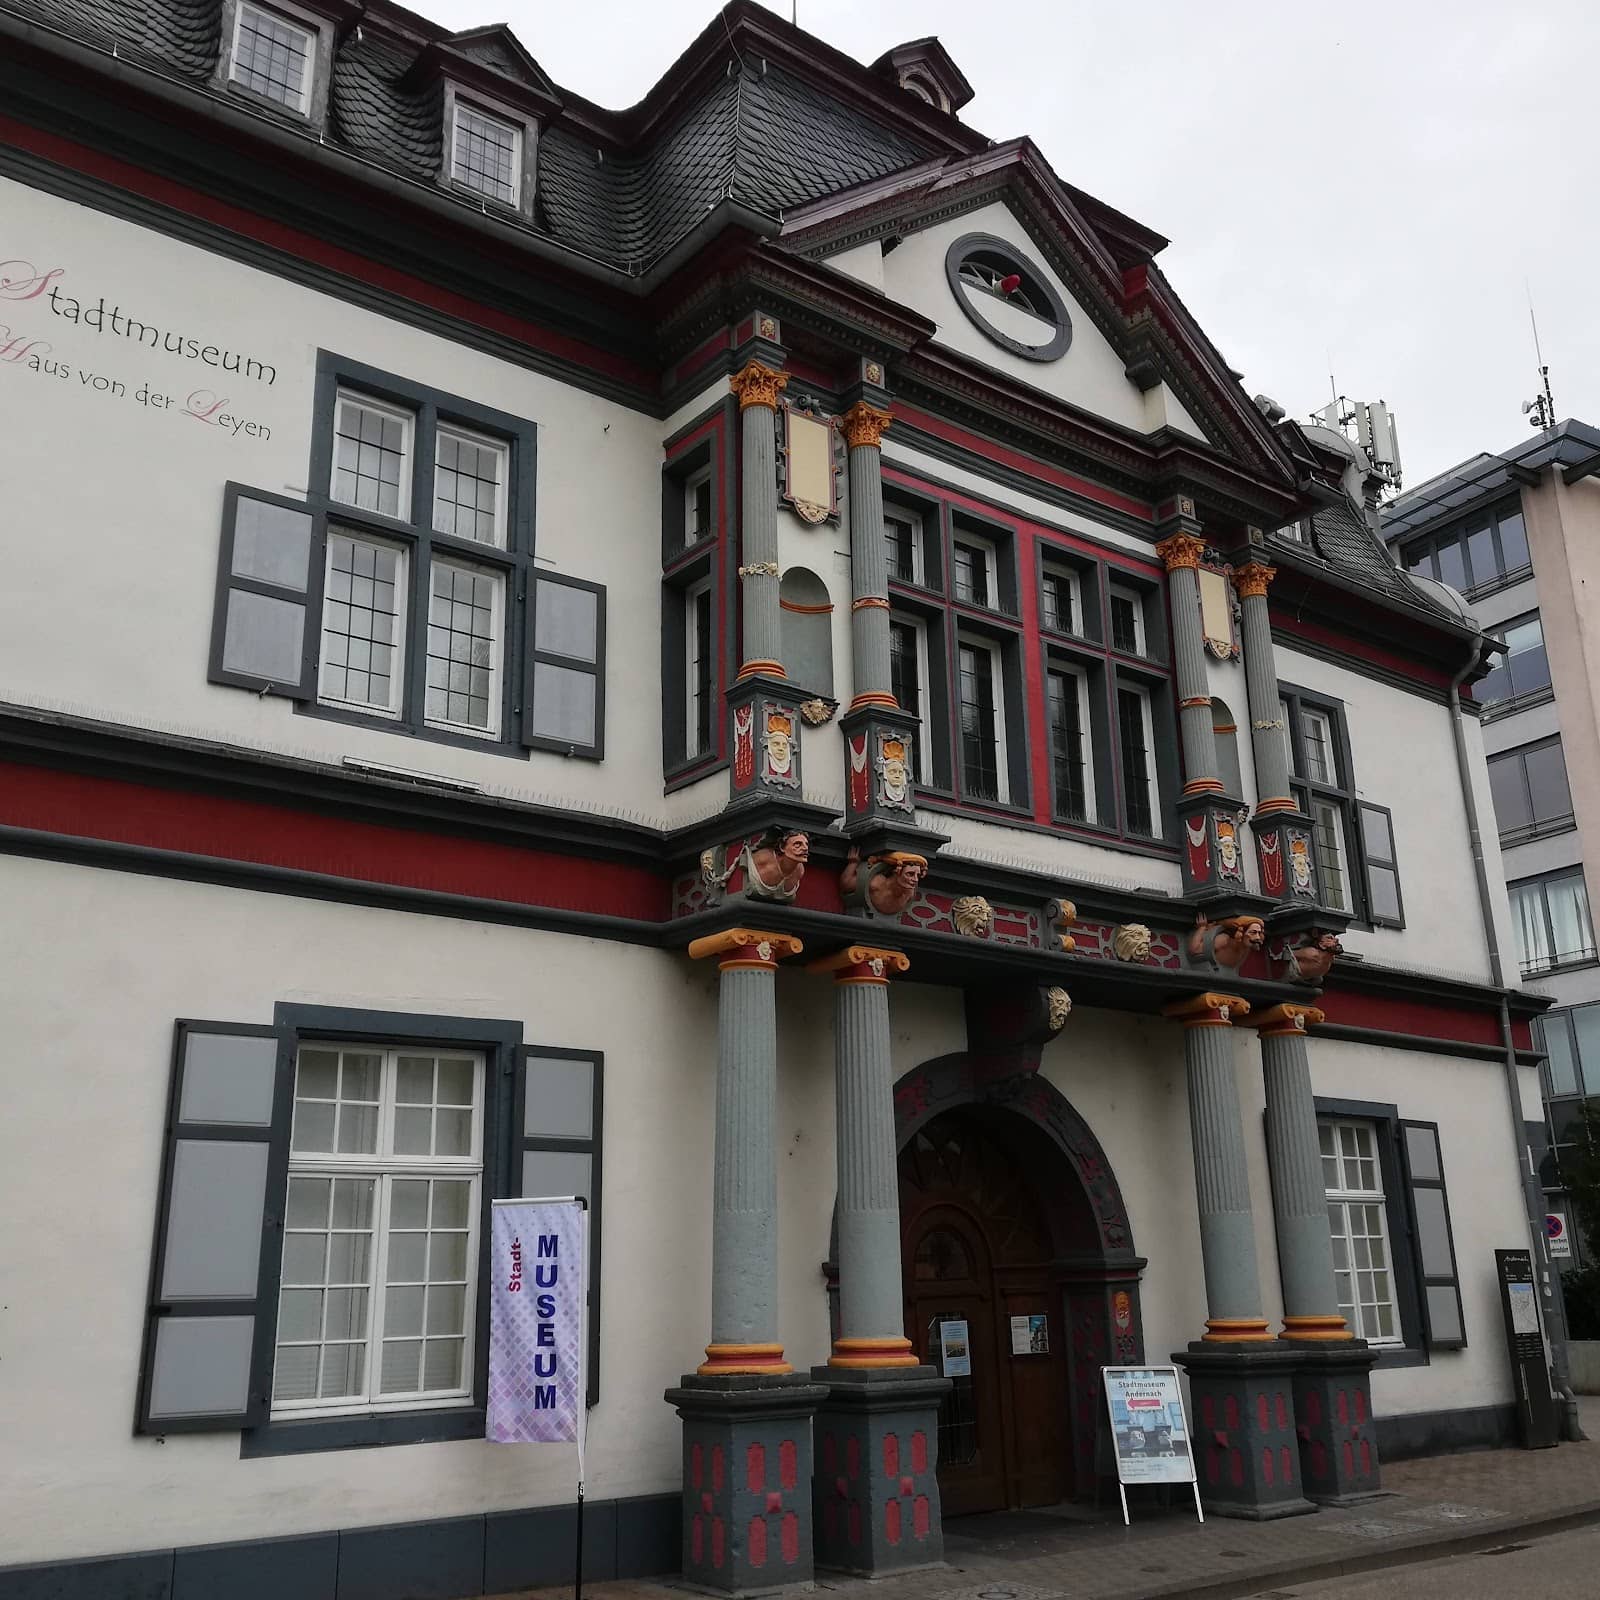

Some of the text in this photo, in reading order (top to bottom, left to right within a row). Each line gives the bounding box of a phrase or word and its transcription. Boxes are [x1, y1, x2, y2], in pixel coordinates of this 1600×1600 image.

[0, 260, 276, 384] Stadtmuseum
[79, 370, 126, 397] von
[135, 383, 175, 409] der
[179, 389, 271, 440] Leyen
[508, 1237, 522, 1293] Stadt-
[534, 1234, 559, 1410] MUSEUM
[1118, 1380, 1166, 1388] Stadtmuseum
[1125, 1390, 1162, 1398] Andernach
